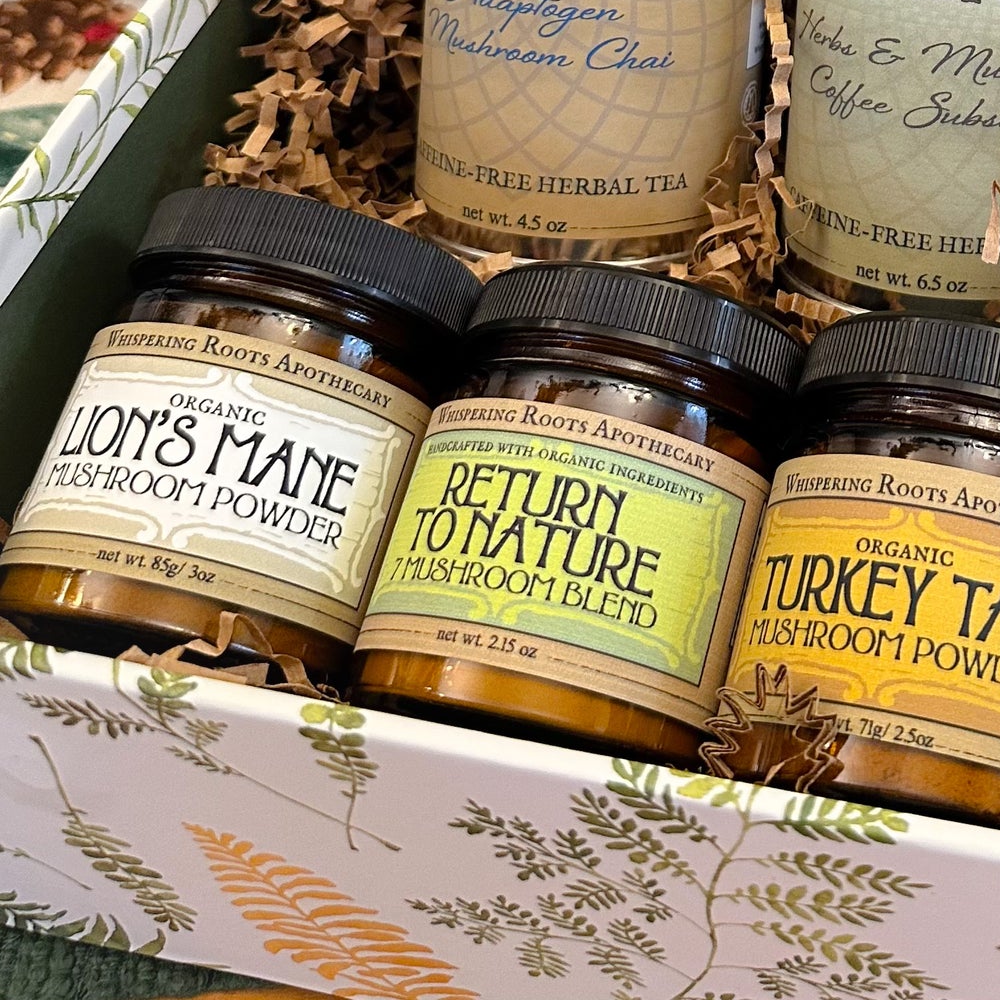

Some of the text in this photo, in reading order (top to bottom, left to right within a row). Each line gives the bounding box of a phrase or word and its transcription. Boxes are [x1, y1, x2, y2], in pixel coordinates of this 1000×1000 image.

[429, 7, 676, 71] Mushroom Chai
[798, 9, 857, 56] Herbs
[868, 38, 906, 65] &
[810, 64, 893, 119] Coffee
[420, 140, 688, 196] FFEINE-FREE HERBAL TEA
[463, 205, 568, 233] net wt. 4.5 oz
[855, 263, 968, 293] net wt. 6.5 oz
[107, 329, 392, 409] WHISPERING ROOTS APOTHECARY
[170, 392, 267, 426] ORGANIC
[59, 405, 359, 516] LION'S MANE
[438, 404, 716, 474] WHISPERING ROOTS APOTHECARY
[427, 440, 705, 504] HANDCRAFTED WITH ORGANIC INGREDIENTS
[440, 461, 628, 534] RETURN
[785, 473, 871, 495] WHISPERING
[877, 472, 948, 503] ROOTS
[46, 462, 344, 550] MUSHROOM POWDER
[97, 548, 216, 584] net wt. 85g/ 3oz
[410, 507, 661, 598] TO NATURE
[856, 537, 954, 567] ORGANIC
[390, 557, 658, 629] 7 MUSHROOM BLEND
[761, 553, 938, 627] TURKEY
[436, 627, 538, 659] net wt. 2.15 oz
[749, 617, 904, 662] MUSHROOM
